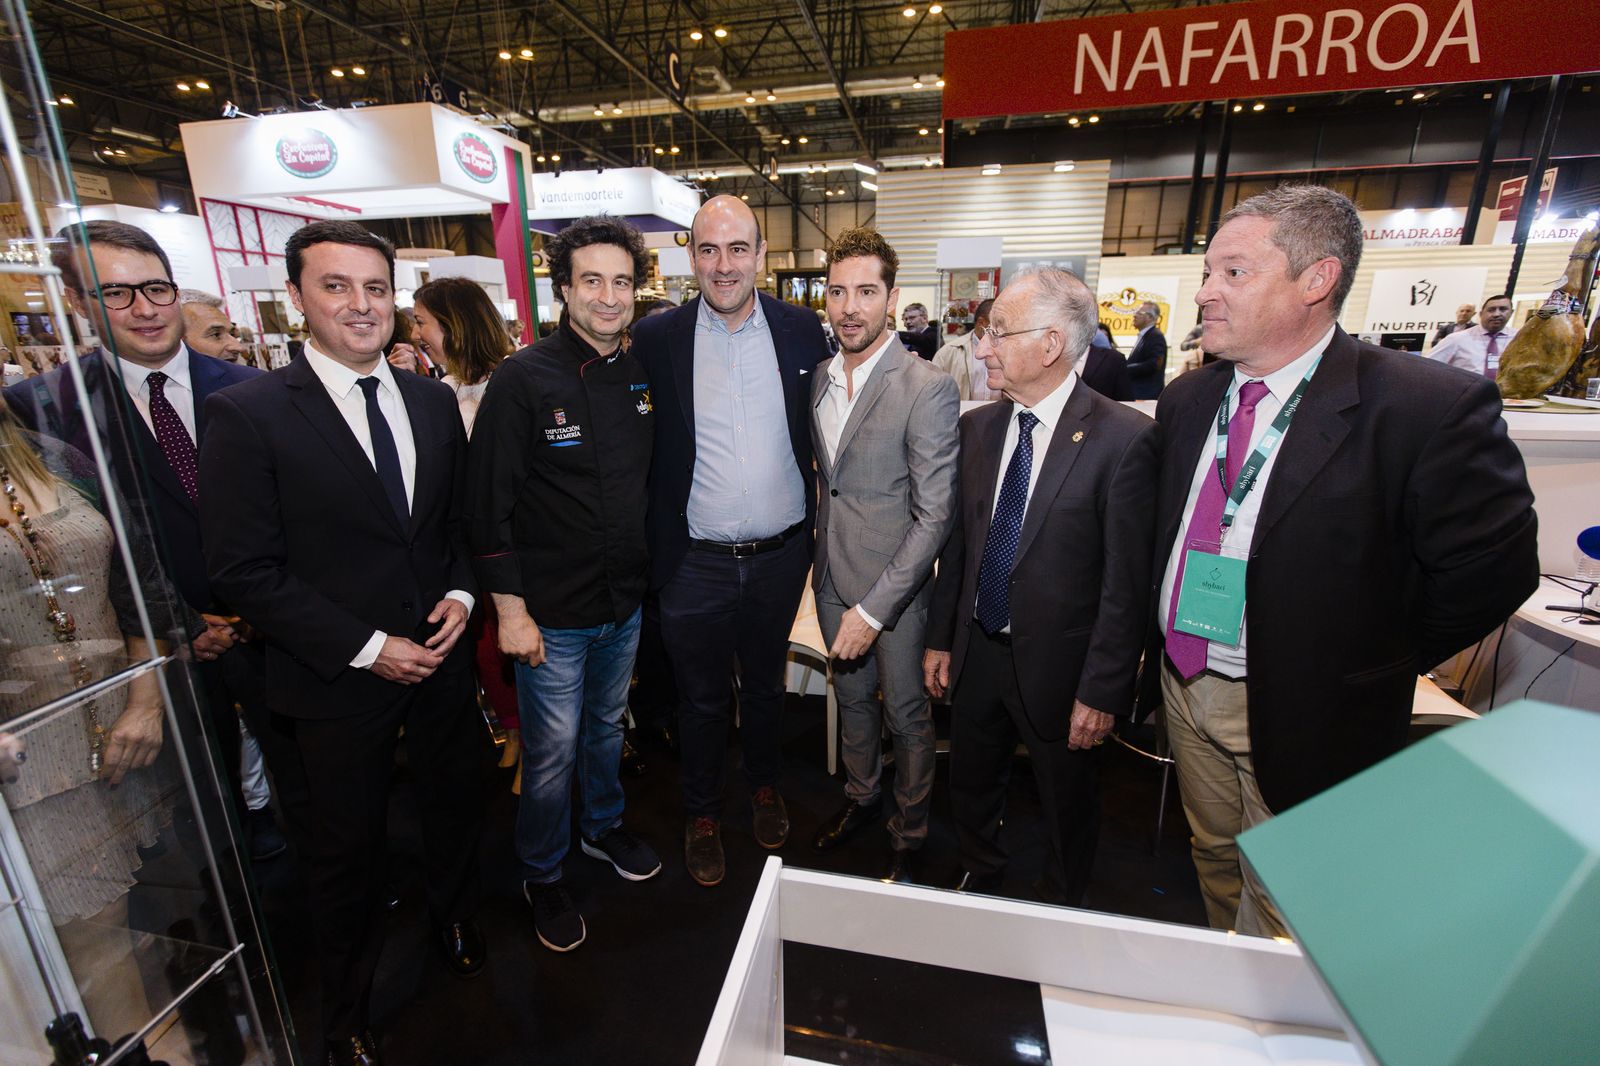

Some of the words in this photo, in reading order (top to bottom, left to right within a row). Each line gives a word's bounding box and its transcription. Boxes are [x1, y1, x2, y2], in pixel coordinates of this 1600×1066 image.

[1073, 0, 1481, 94] NAFARROA
[432, 83, 442, 102] 6
[459, 90, 468, 109] 6
[540, 188, 624, 203] Vandemoortele
[545, 425, 580, 435] DIPUTACIÓN
[546, 433, 556, 441] DE
[556, 431, 581, 440] ALMERÍA
